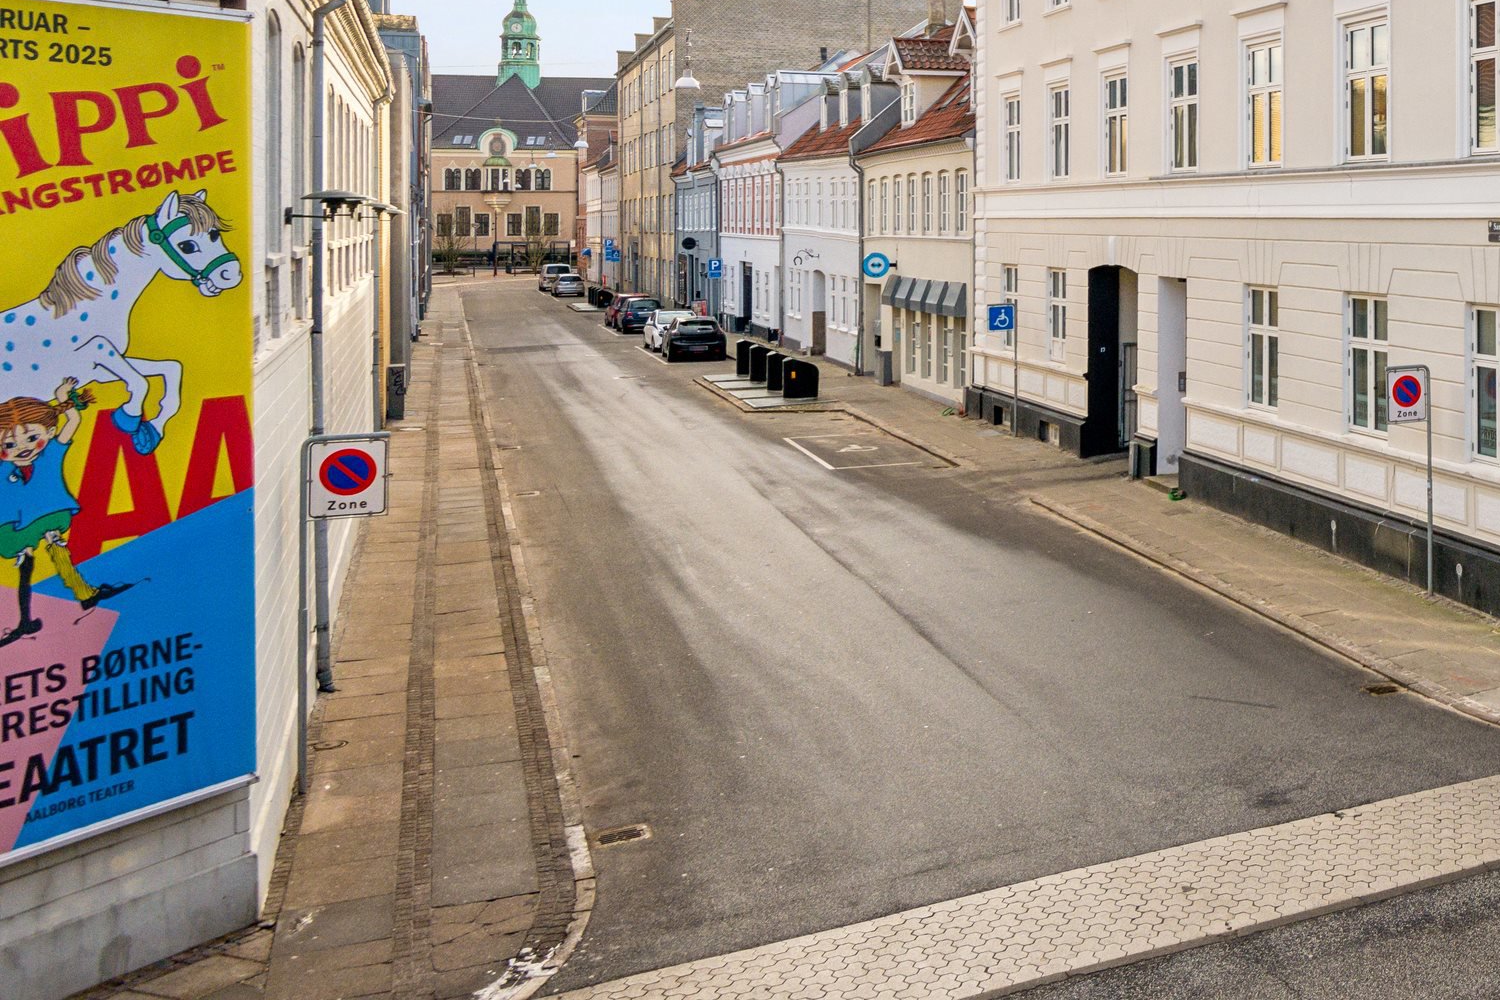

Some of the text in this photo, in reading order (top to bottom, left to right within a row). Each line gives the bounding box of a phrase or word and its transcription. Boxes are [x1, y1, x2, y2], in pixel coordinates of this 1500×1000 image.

[48, 42, 113, 67] 2025
[711, 261, 720, 271] P
[1397, 410, 1418, 418] Zone
[327, 500, 368, 511] Zone
[0, 632, 203, 705] ETS BØRNE-
[1, 667, 194, 742] RESTILLING
[24, 780, 135, 825] AALBORG TEATER
